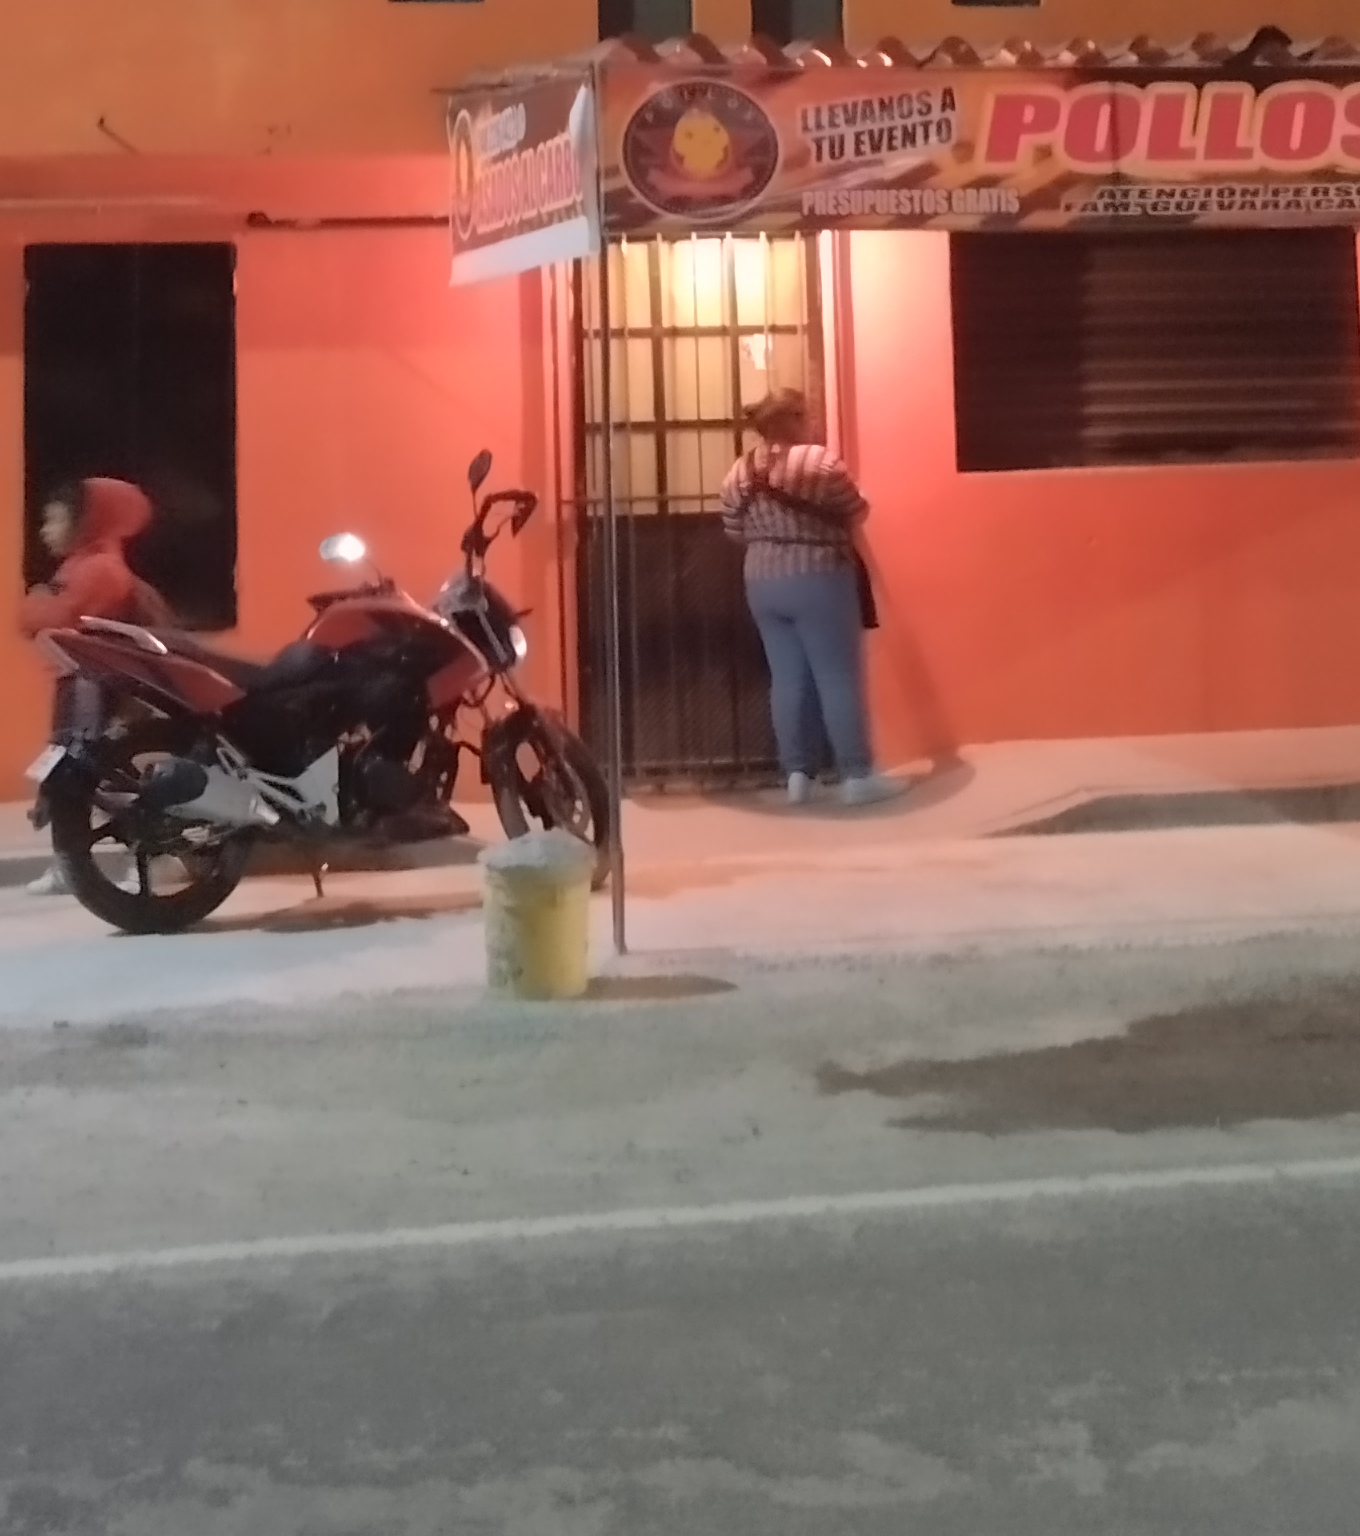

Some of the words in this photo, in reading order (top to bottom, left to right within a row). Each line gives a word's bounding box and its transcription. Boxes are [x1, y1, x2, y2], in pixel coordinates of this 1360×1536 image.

[801, 89, 932, 133] LLEVANOS
[940, 86, 956, 112] A
[813, 133, 845, 162] TU
[854, 117, 952, 157] EVENTO
[801, 188, 949, 215] PRESUPUESTOS
[951, 188, 1020, 214] GRATIS
[1149, 198, 1304, 213] GUEVARA
